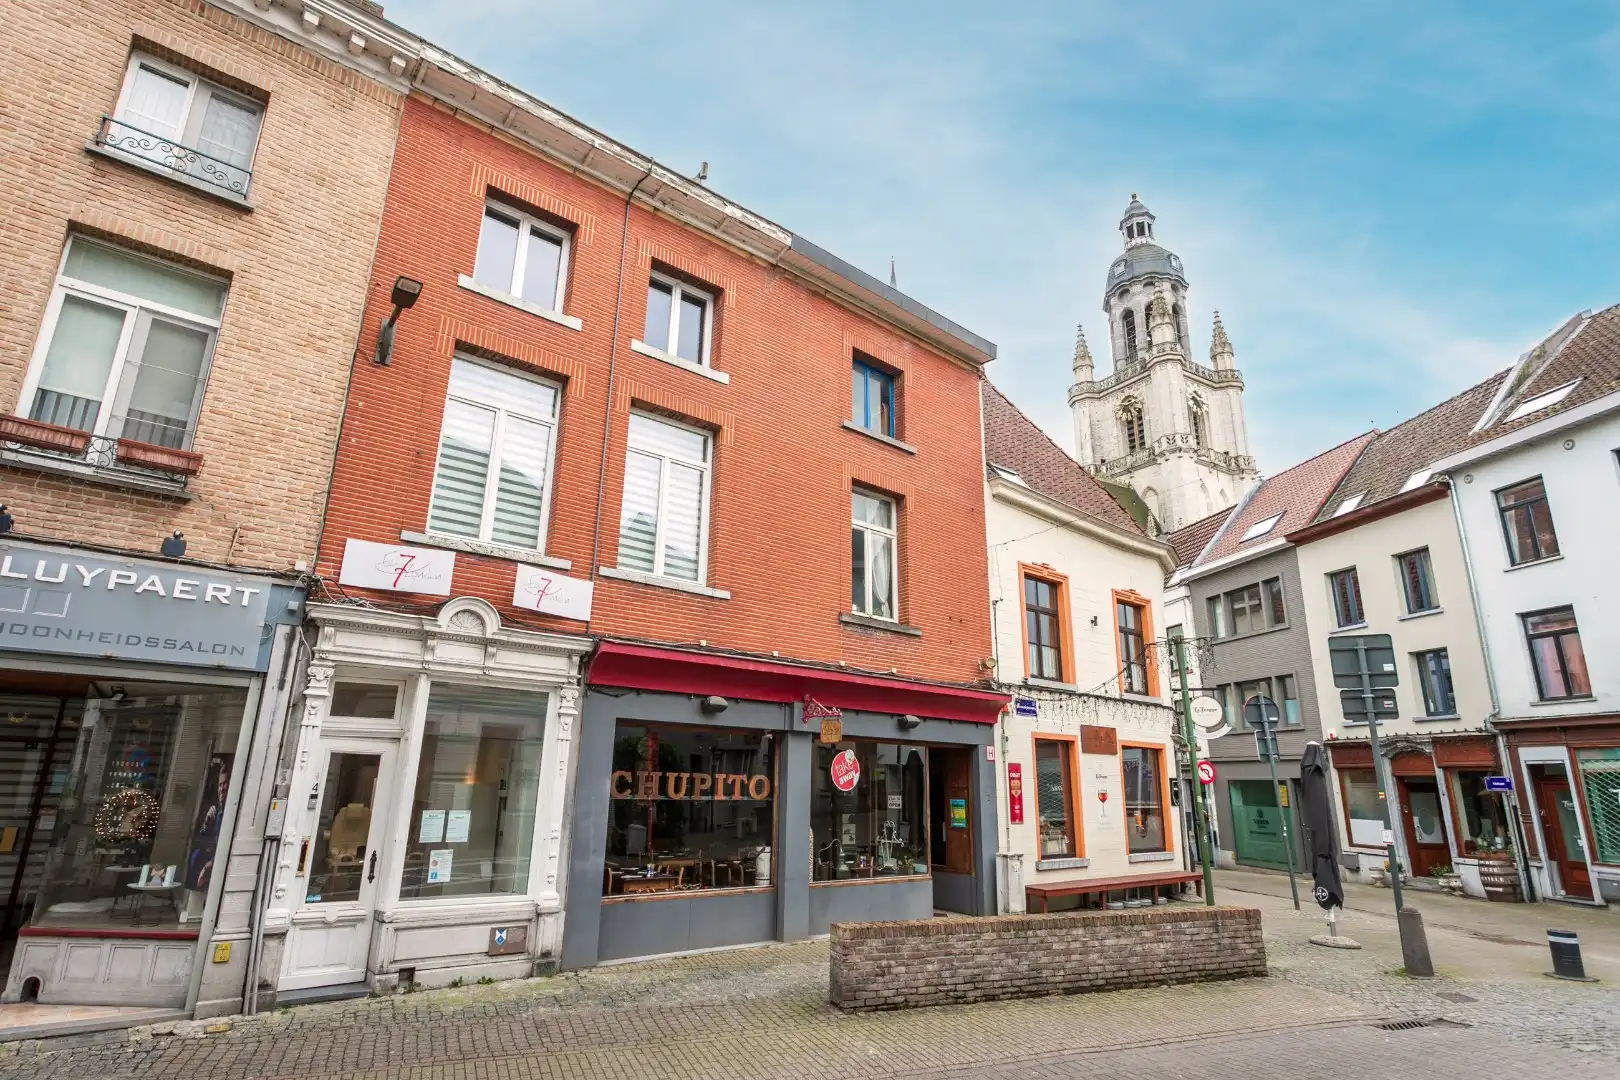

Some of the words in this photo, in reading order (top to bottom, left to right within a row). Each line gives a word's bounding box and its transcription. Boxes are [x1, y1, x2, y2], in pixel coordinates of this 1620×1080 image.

[0, 555, 260, 607] LUYPAERT
[393, 553, 416, 588] 7
[536, 576, 553, 609] 7
[835, 760, 854, 776] take
[838, 769, 856, 785] away
[311, 782, 319, 793] 4
[610, 770, 771, 800] CHUPITO
